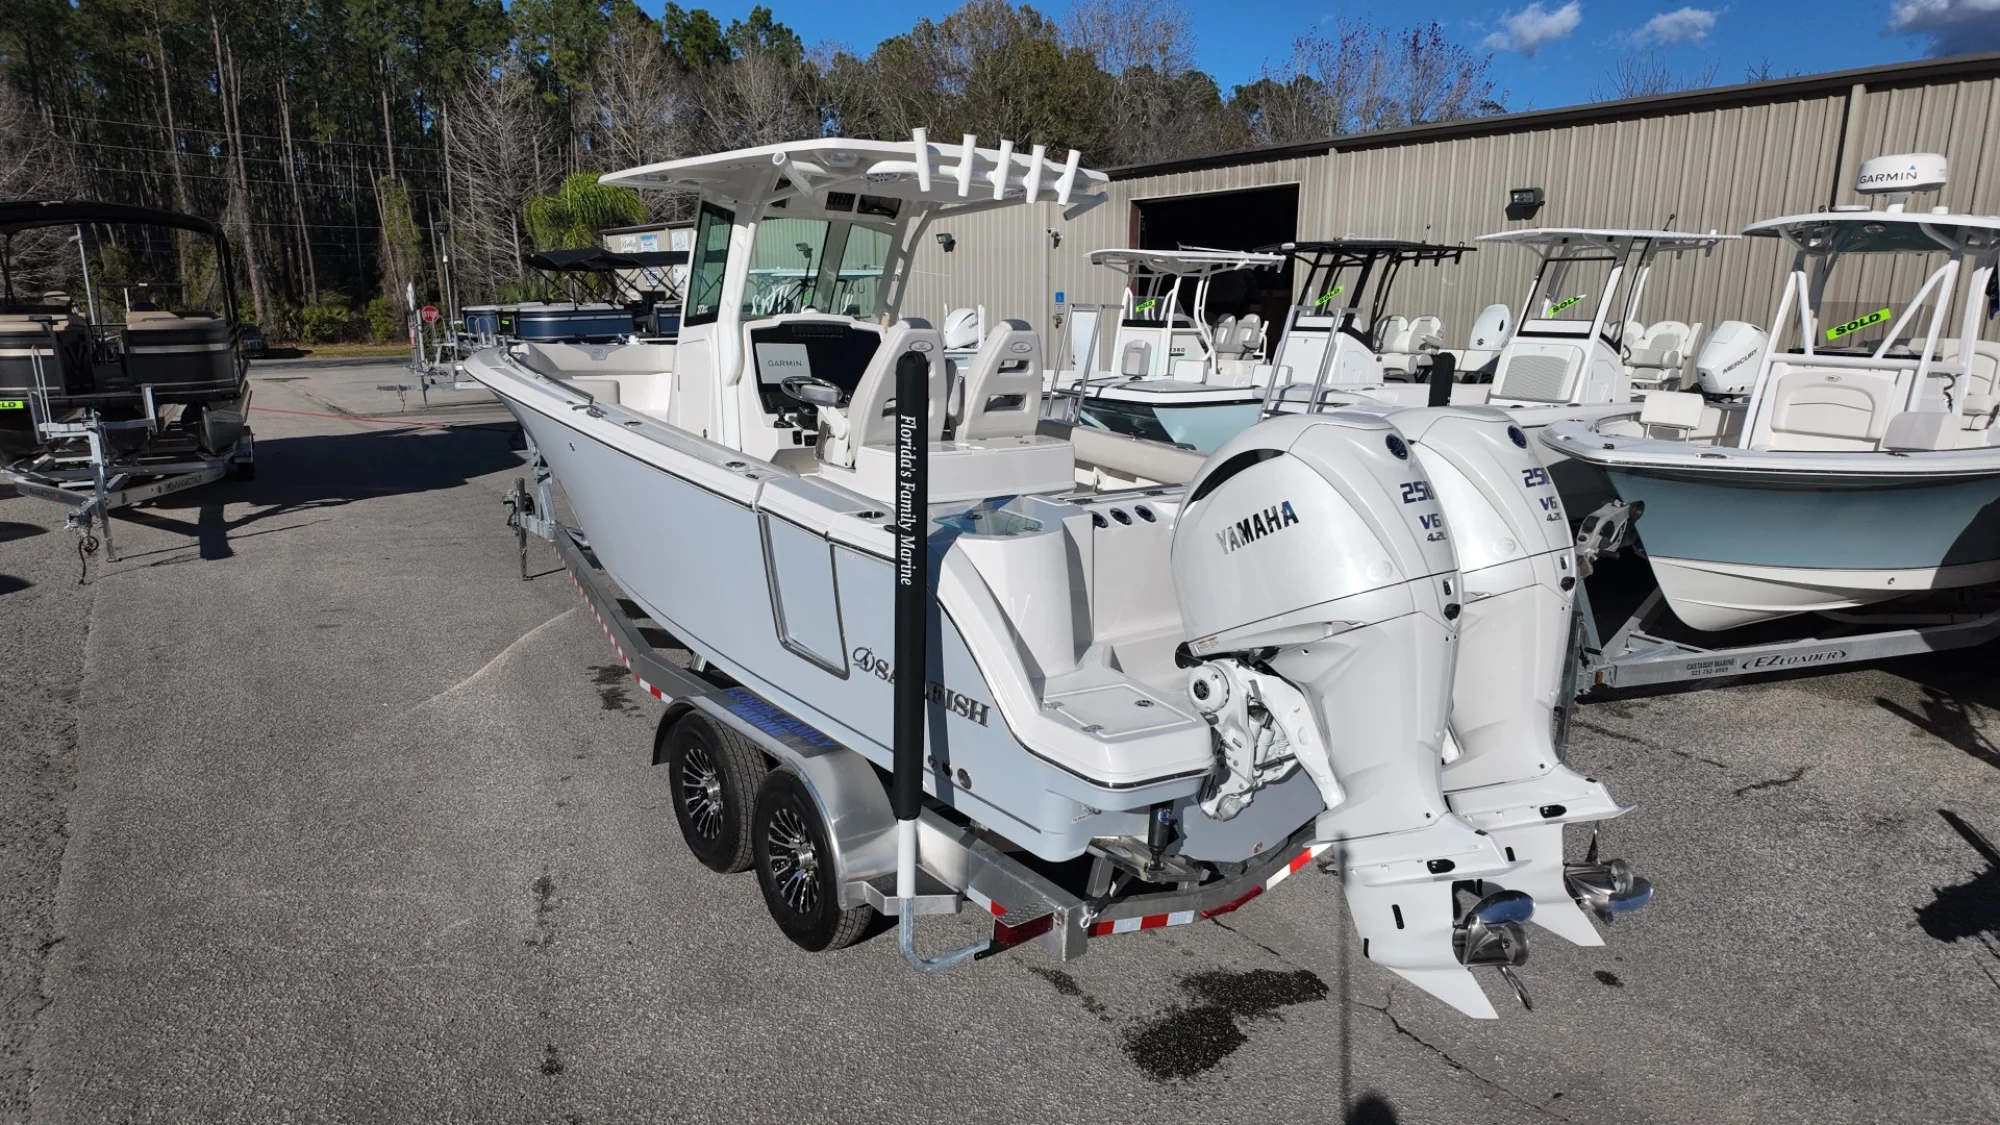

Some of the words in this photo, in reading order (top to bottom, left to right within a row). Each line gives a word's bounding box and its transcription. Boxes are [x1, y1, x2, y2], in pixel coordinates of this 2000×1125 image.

[1860, 171, 1917, 184] GARMIN
[423, 310, 437, 318] STOP
[1835, 313, 1882, 336] SOLD
[767, 359, 803, 367] GARMIN
[1722, 347, 1758, 375] MERCURY
[900, 414, 917, 478] Florida's
[898, 481, 917, 532] Family
[1538, 496, 1558, 511] V6
[1215, 500, 1299, 555] YAMAHA
[1419, 513, 1442, 530] V6
[900, 535, 917, 586] Marine
[1715, 658, 1735, 667] MARINE
[727, 703, 791, 738] MARINE
